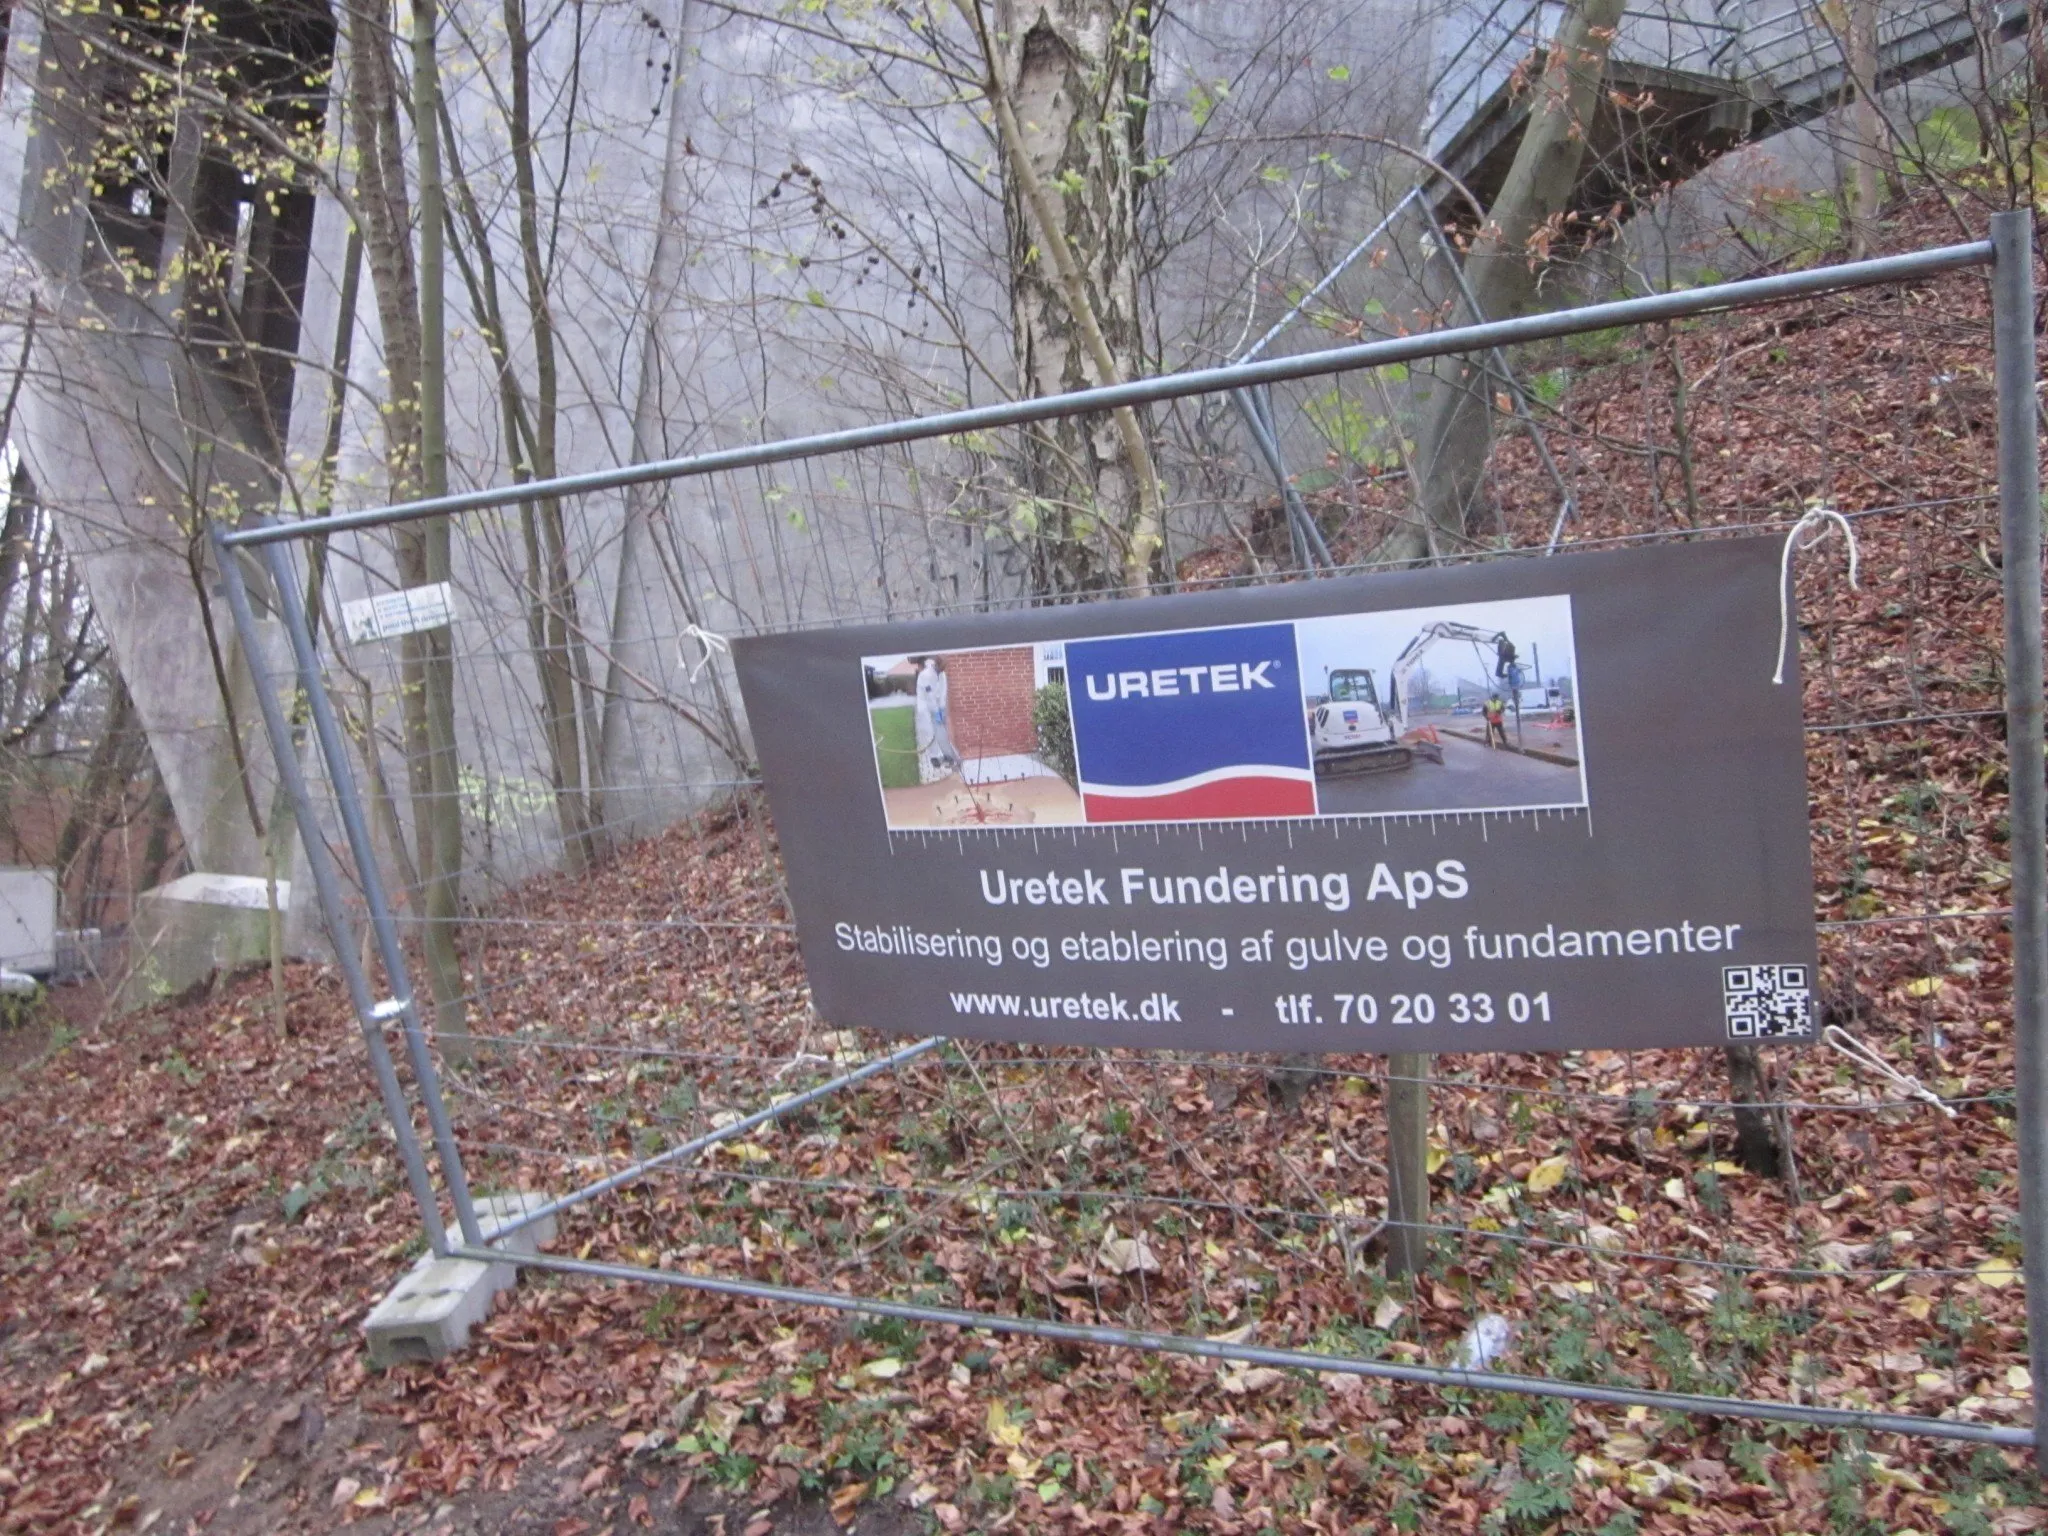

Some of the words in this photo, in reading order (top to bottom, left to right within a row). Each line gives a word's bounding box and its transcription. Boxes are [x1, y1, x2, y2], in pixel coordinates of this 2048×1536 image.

[979, 868, 1110, 905] Uretek
[1120, 865, 1350, 912] Fundering
[1366, 859, 1469, 910] ApS
[834, 922, 1003, 966] Stabilisering
[1011, 936, 1050, 968] og
[1060, 930, 1228, 971] etablering
[1240, 929, 1274, 962] af
[1286, 928, 1388, 971] gulve
[1402, 934, 1452, 969] og
[1464, 919, 1741, 959] fundamenter
[949, 992, 1182, 1022] www.uretek.dk
[1274, 993, 1323, 1024] tlf.
[1333, 993, 1378, 1024] 70
[1390, 993, 1435, 1024] 20
[1448, 992, 1495, 1023] 33
[1507, 991, 1551, 1023] 01
